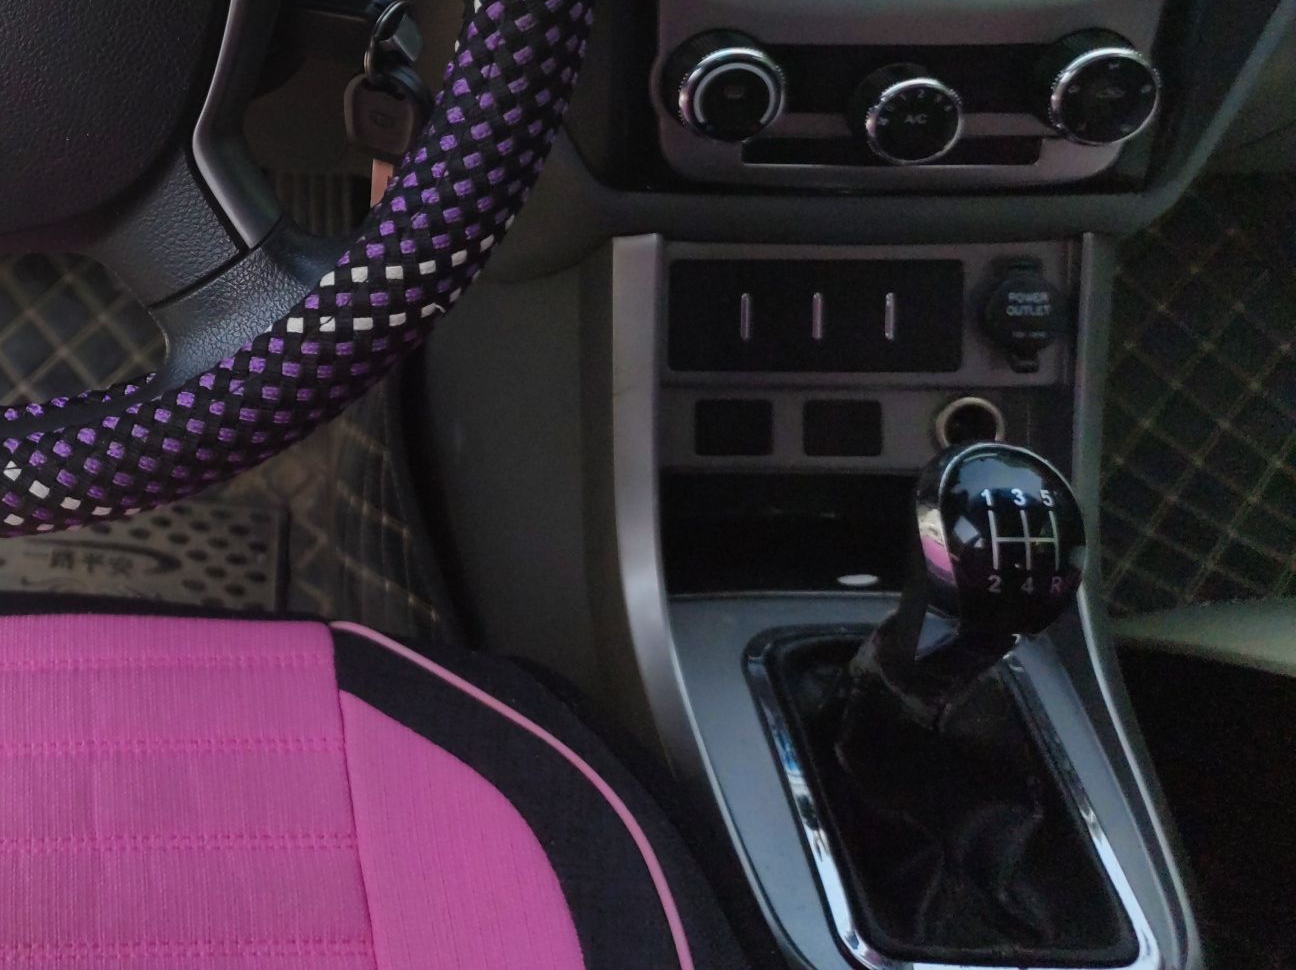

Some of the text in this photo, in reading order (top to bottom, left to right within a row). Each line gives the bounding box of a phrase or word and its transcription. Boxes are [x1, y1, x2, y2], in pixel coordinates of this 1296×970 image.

[1008, 292, 1049, 303] POWER
[1006, 305, 1051, 317] OUTLET
[980, 488, 992, 507] 1
[1010, 488, 1026, 507] 3
[1039, 489, 1054, 507] 5
[987, 574, 1002, 594] 2
[1020, 575, 1034, 594] 4
[1050, 575, 1064, 594] R
